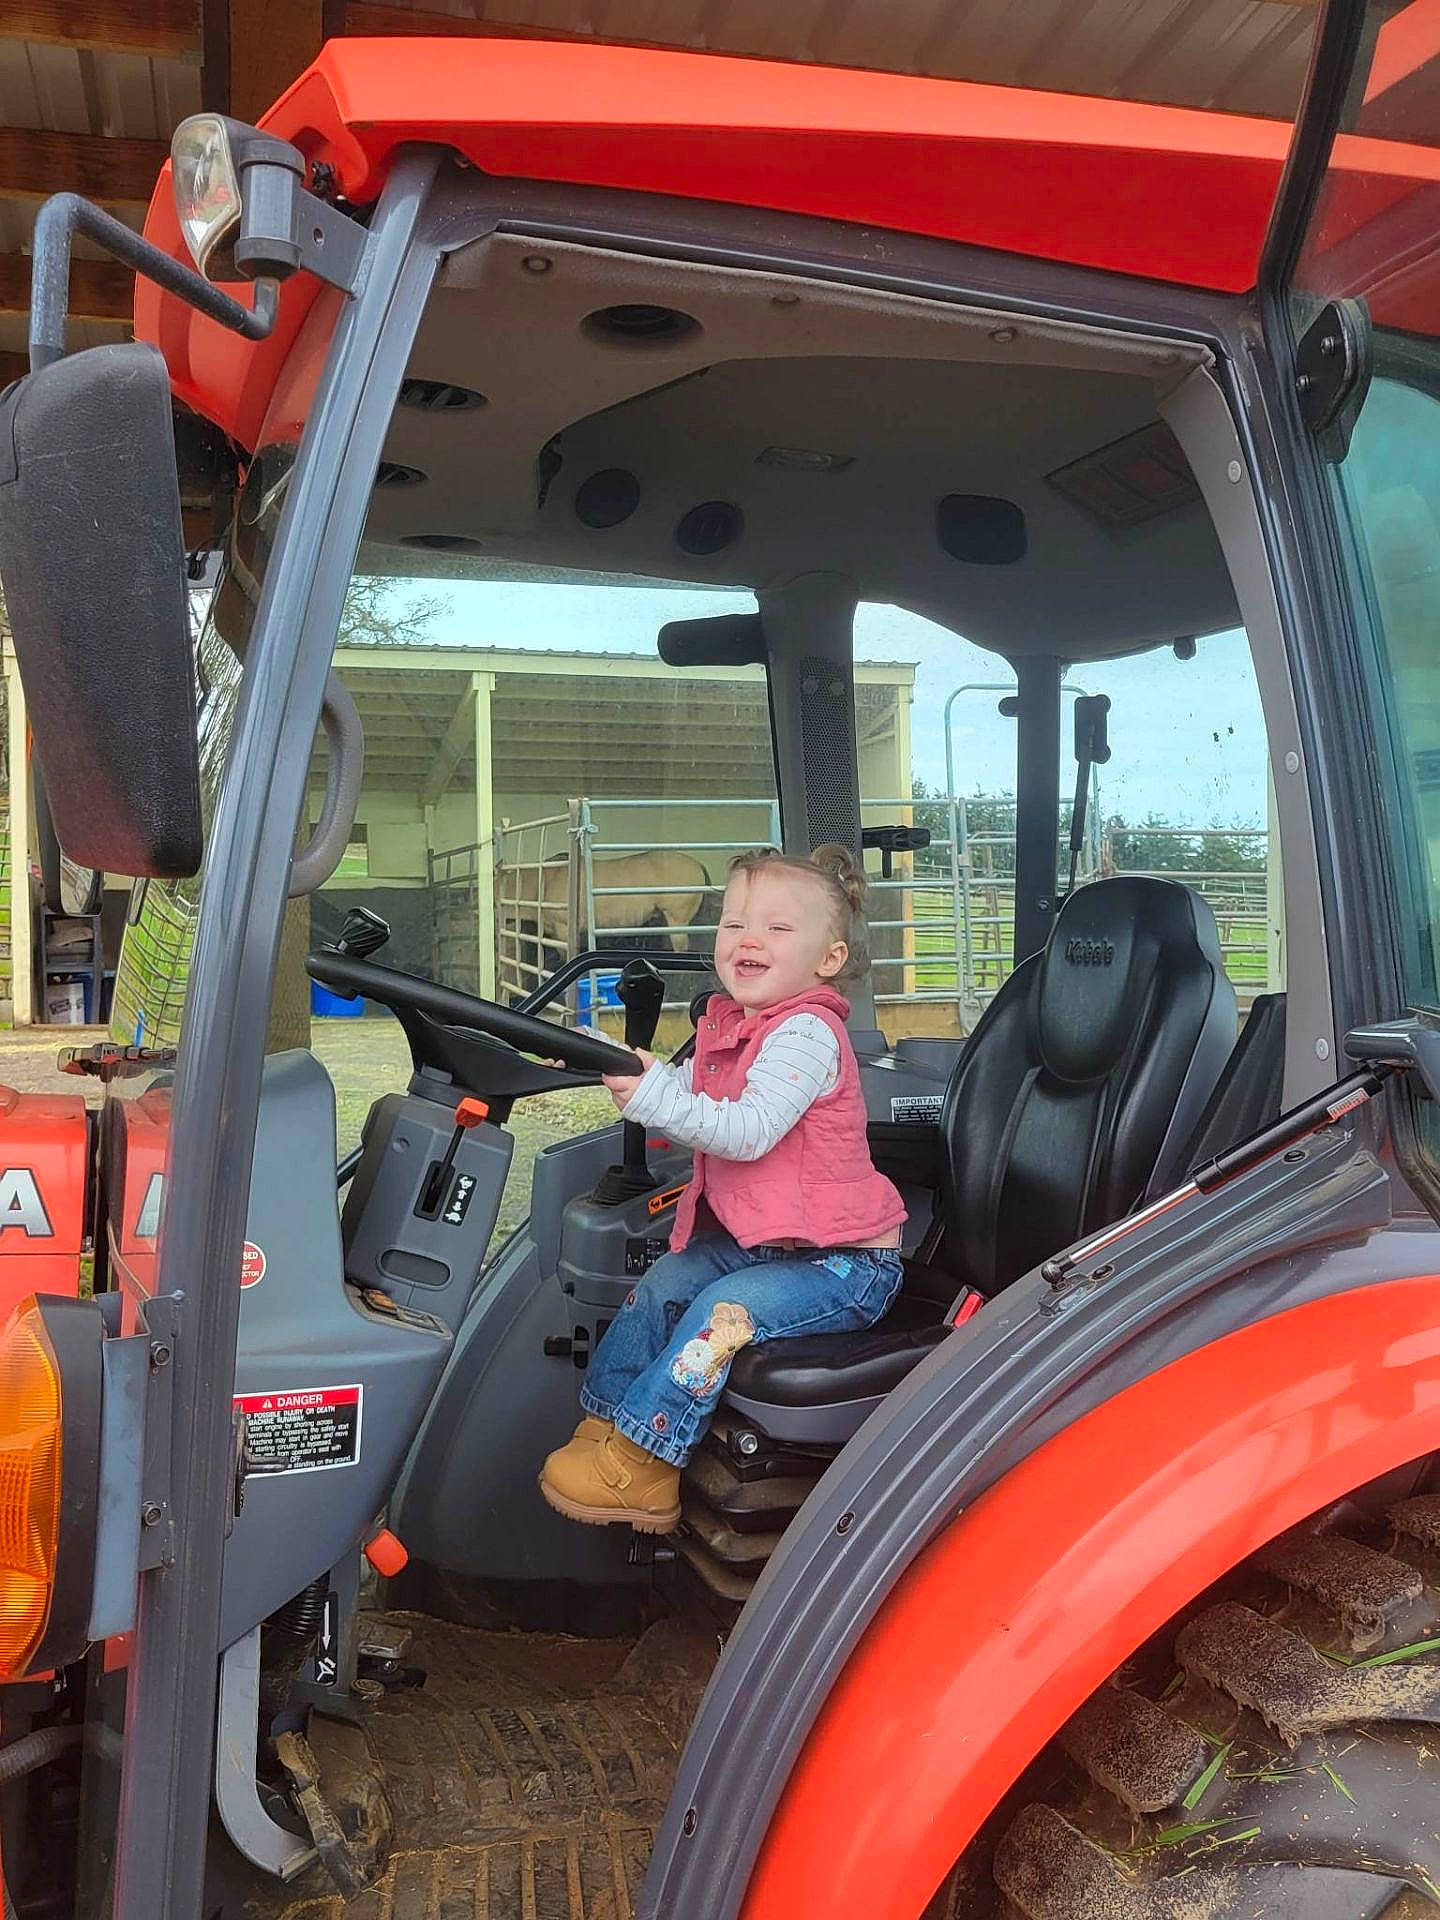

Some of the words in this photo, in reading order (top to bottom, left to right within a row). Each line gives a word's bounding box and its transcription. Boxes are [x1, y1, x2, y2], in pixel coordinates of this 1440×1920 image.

[277, 1394, 323, 1407] DANGER
[253, 1411, 281, 1419] POSSIBLE
[283, 1409, 303, 1417] INJURY
[265, 1424, 282, 1432] engine
[294, 1421, 314, 1429] shorting
[282, 1428, 308, 1437] bypassing
[321, 1424, 336, 1433] safety
[250, 1438, 273, 1446] Machine
[275, 1436, 286, 1444] may
